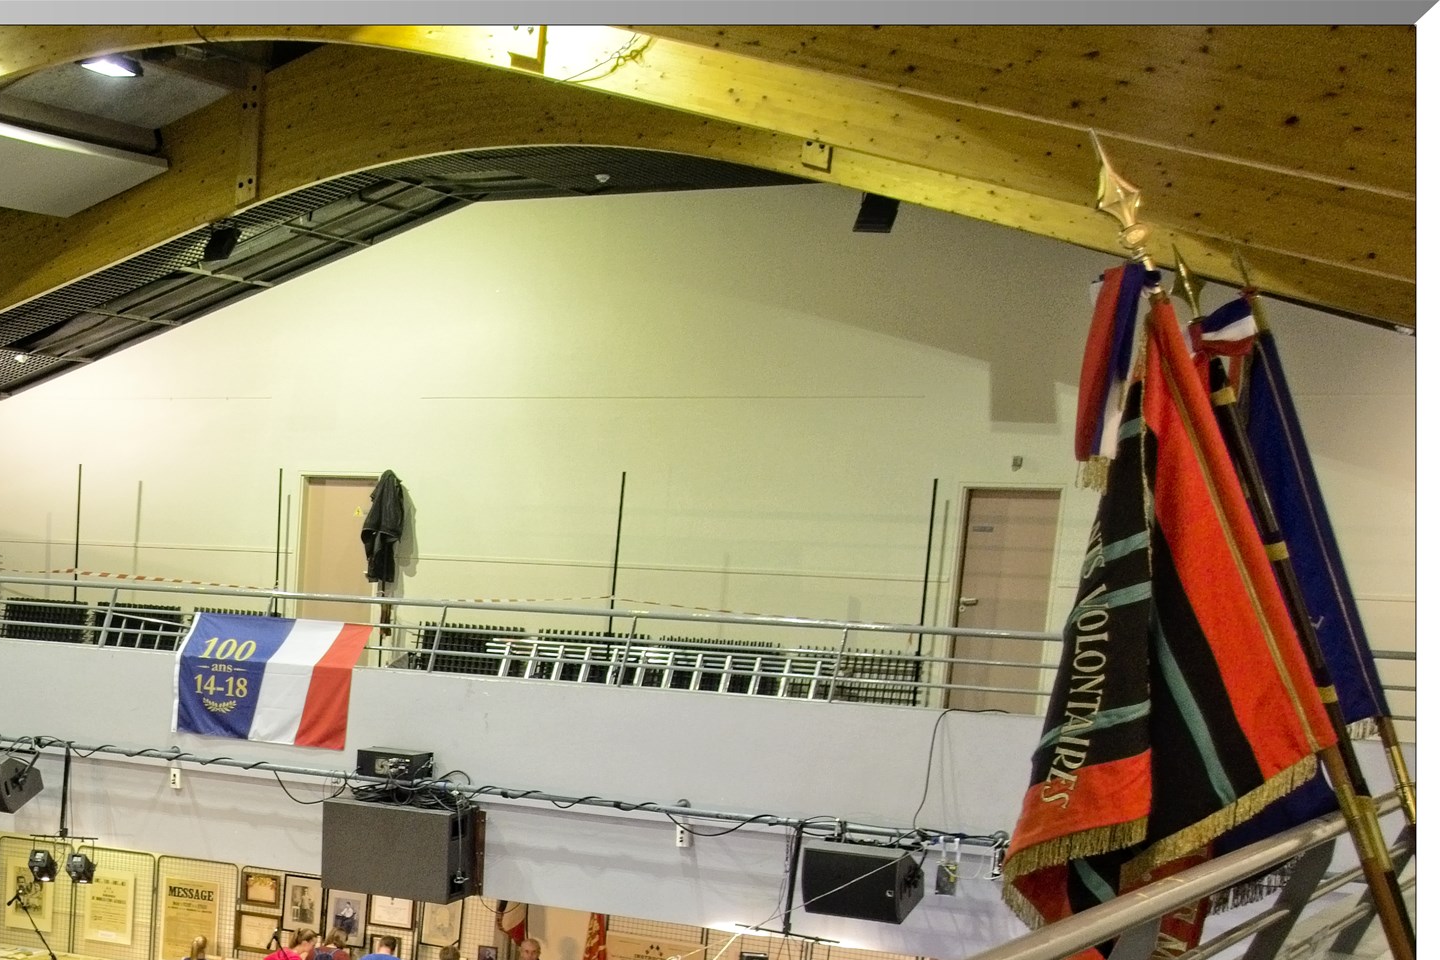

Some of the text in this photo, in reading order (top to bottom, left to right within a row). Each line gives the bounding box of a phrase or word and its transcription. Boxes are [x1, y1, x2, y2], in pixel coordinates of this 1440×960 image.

[199, 637, 257, 661] 100
[211, 662, 233, 673] ans
[193, 674, 248, 698] 14-18
[1040, 584, 1110, 809] VOLONTAIRES
[168, 885, 214, 902] MESSAGE
